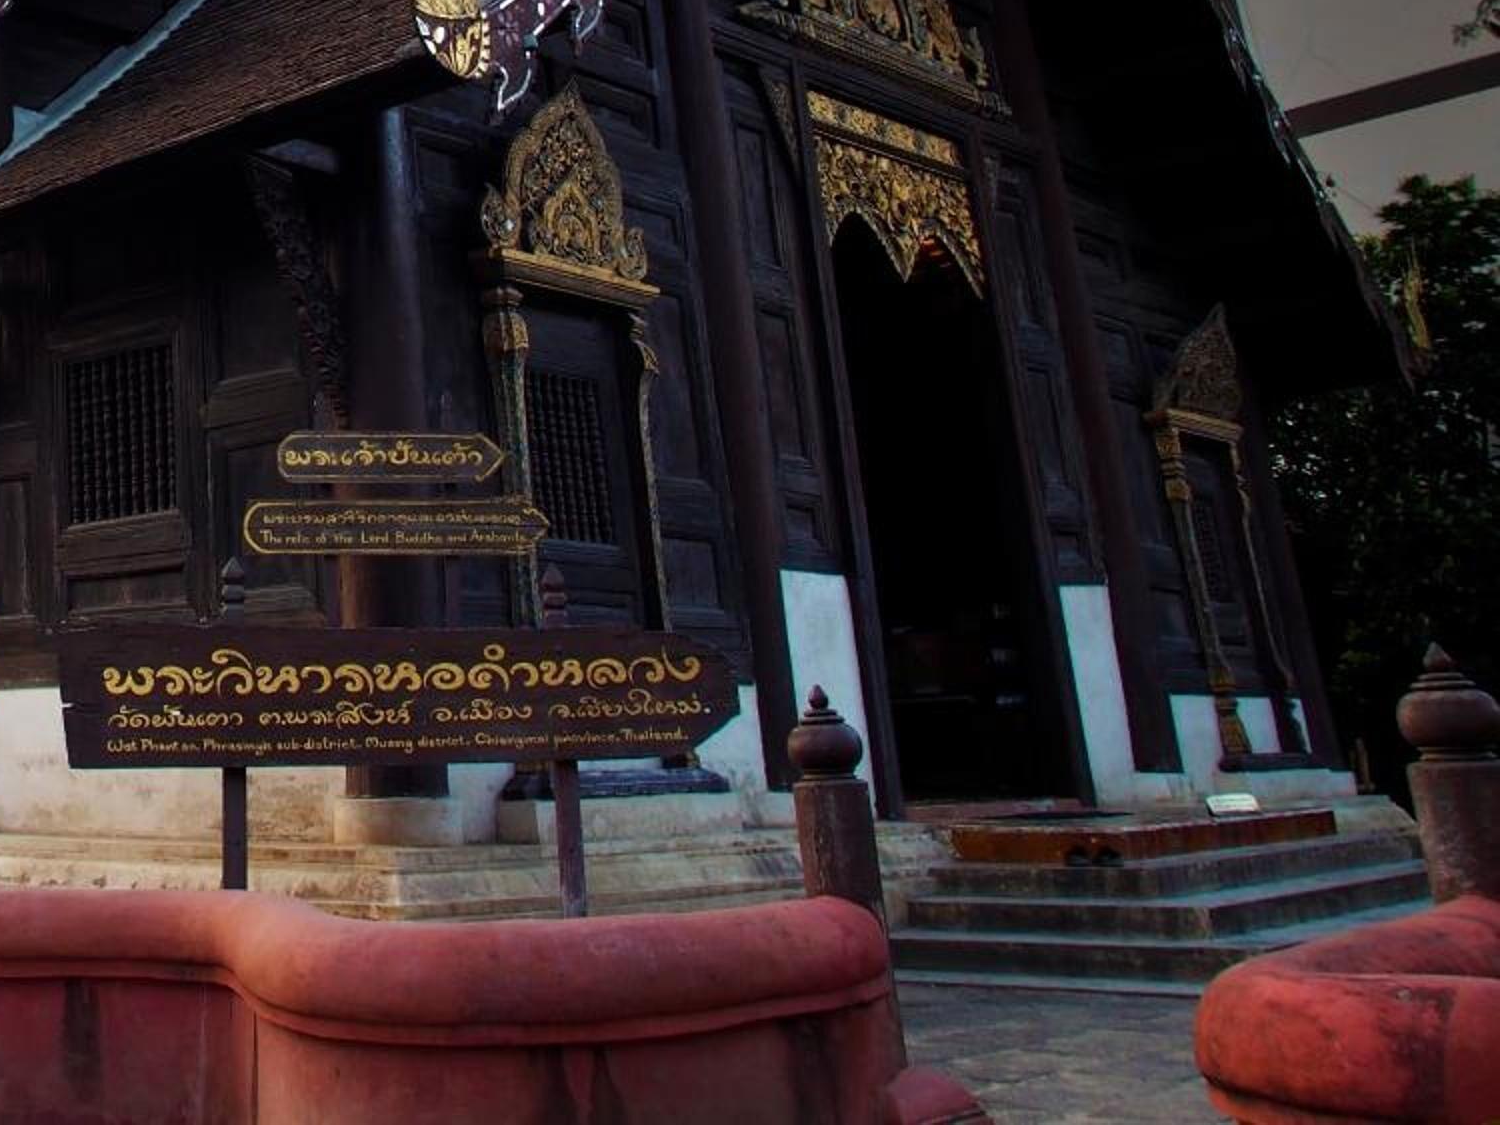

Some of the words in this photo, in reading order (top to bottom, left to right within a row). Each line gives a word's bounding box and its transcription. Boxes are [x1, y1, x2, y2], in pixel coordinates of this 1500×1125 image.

[260, 529, 282, 544] The
[333, 531, 354, 544] the
[361, 530, 390, 544] Lord
[395, 530, 443, 544] Buddha
[448, 531, 467, 543] and
[103, 644, 701, 697] พระวิหารหอคำหลวง
[108, 704, 244, 728] วัดพันเตา
[259, 699, 416, 729] ต.พระสิงห์
[430, 698, 533, 722] อ.เมือง
[107, 739, 137, 752] Wat
[365, 736, 413, 754] Muang
